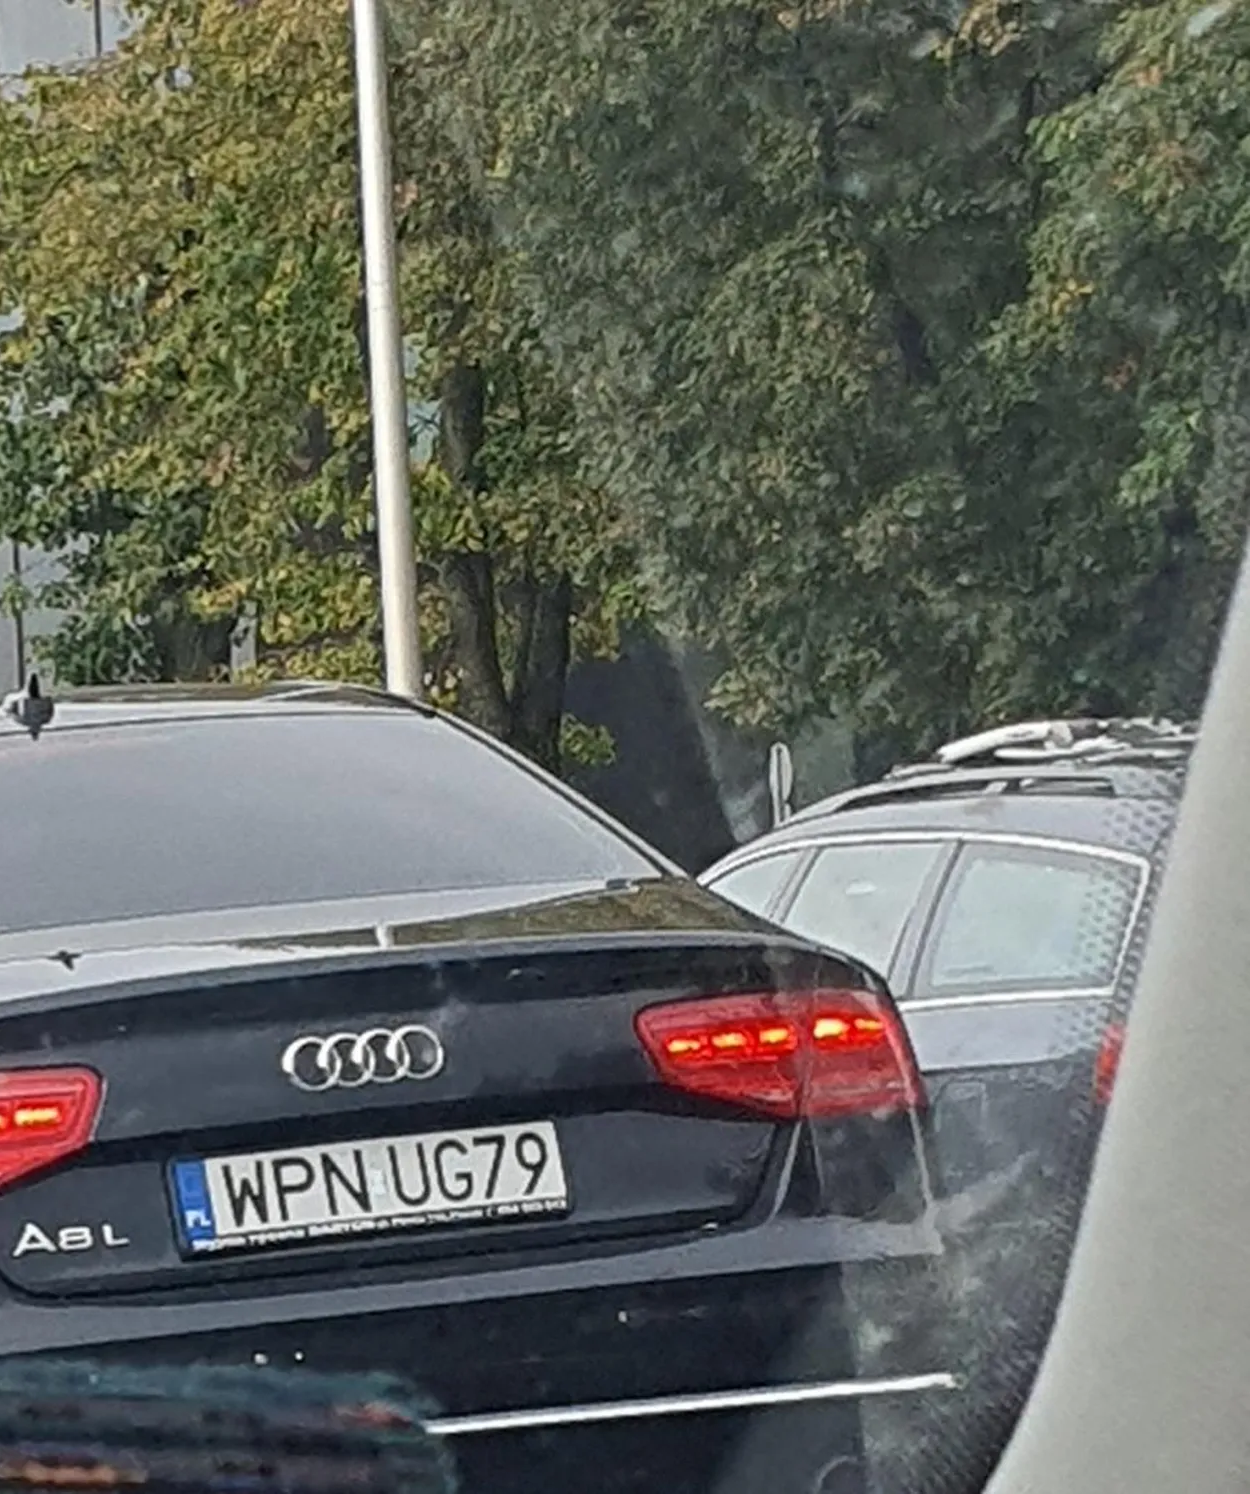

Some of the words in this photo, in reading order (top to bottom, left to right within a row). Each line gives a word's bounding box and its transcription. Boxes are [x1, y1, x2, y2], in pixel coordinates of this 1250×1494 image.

[222, 1149, 372, 1230] WPN
[387, 1131, 549, 1208] UG79
[186, 1208, 212, 1227] PL
